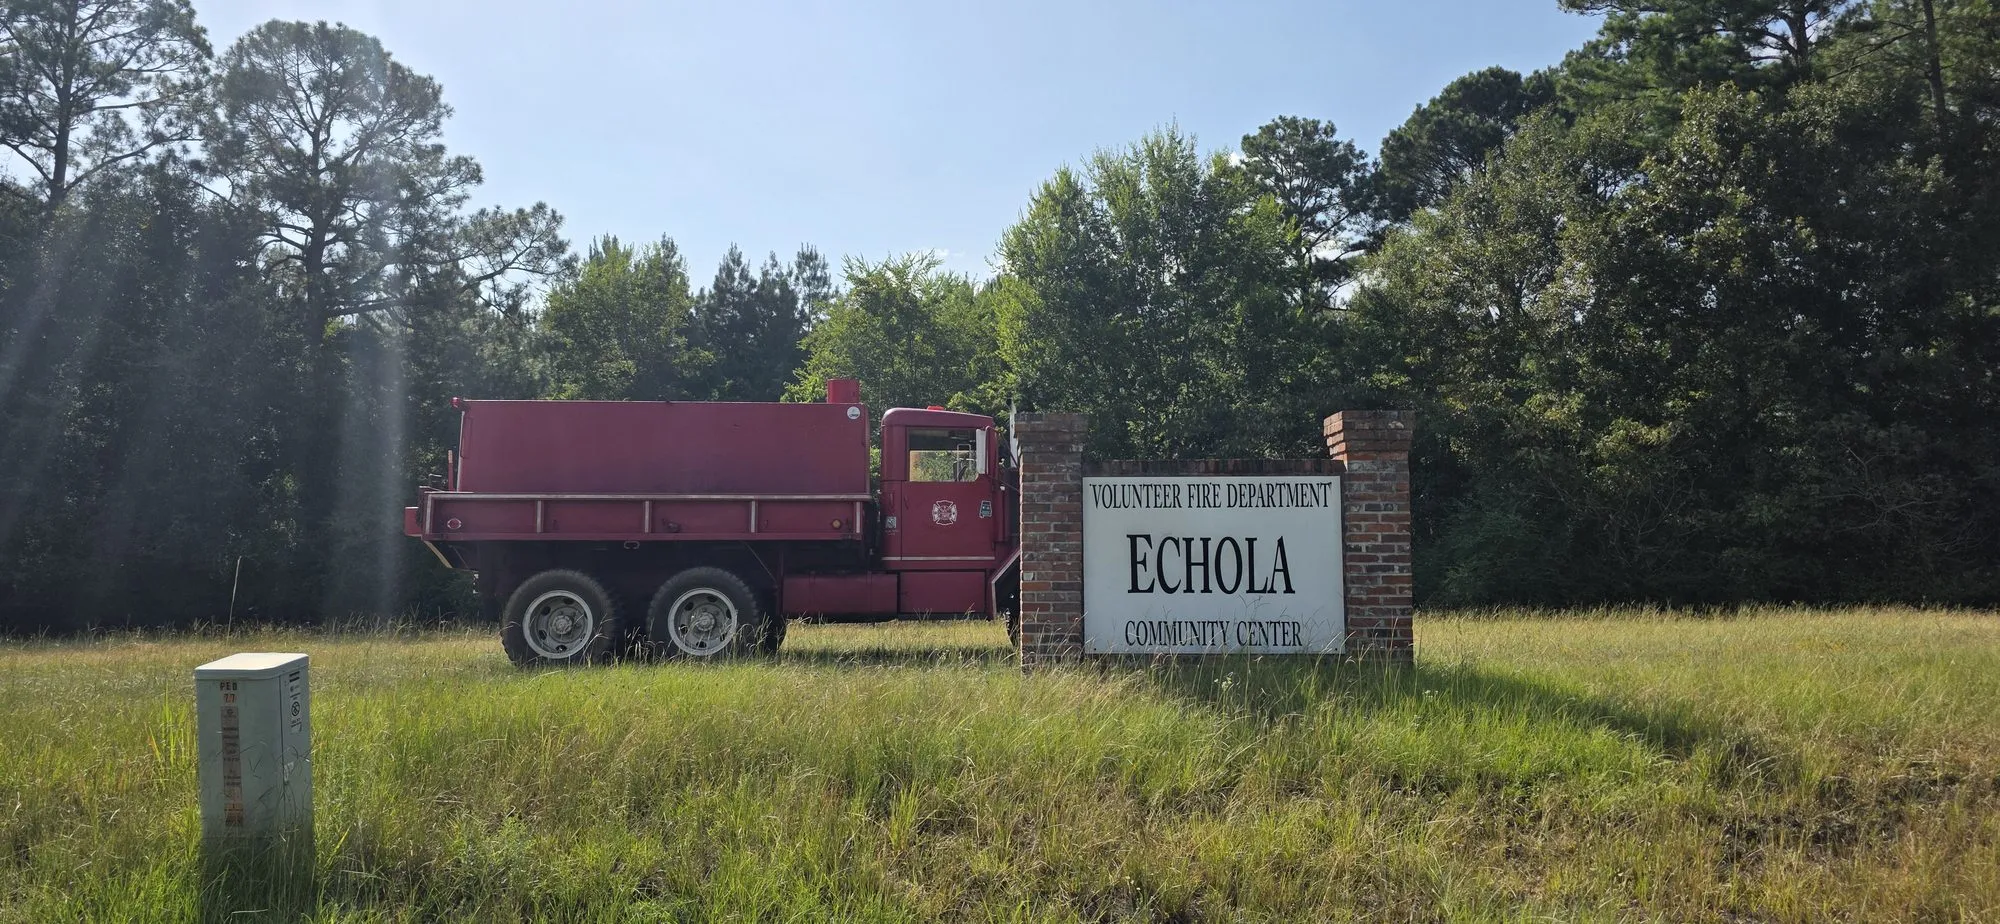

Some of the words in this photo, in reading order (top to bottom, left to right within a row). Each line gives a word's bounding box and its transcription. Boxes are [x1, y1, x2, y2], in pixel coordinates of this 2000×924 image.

[1091, 483, 1182, 509] VOLUNTEER
[1187, 483, 1222, 508] FIRE
[1227, 482, 1332, 508] DEPARTMENT
[1126, 534, 1296, 594] ECHOLA
[1125, 620, 1230, 647] COMMUNITY
[1236, 620, 1303, 647] CENTER
